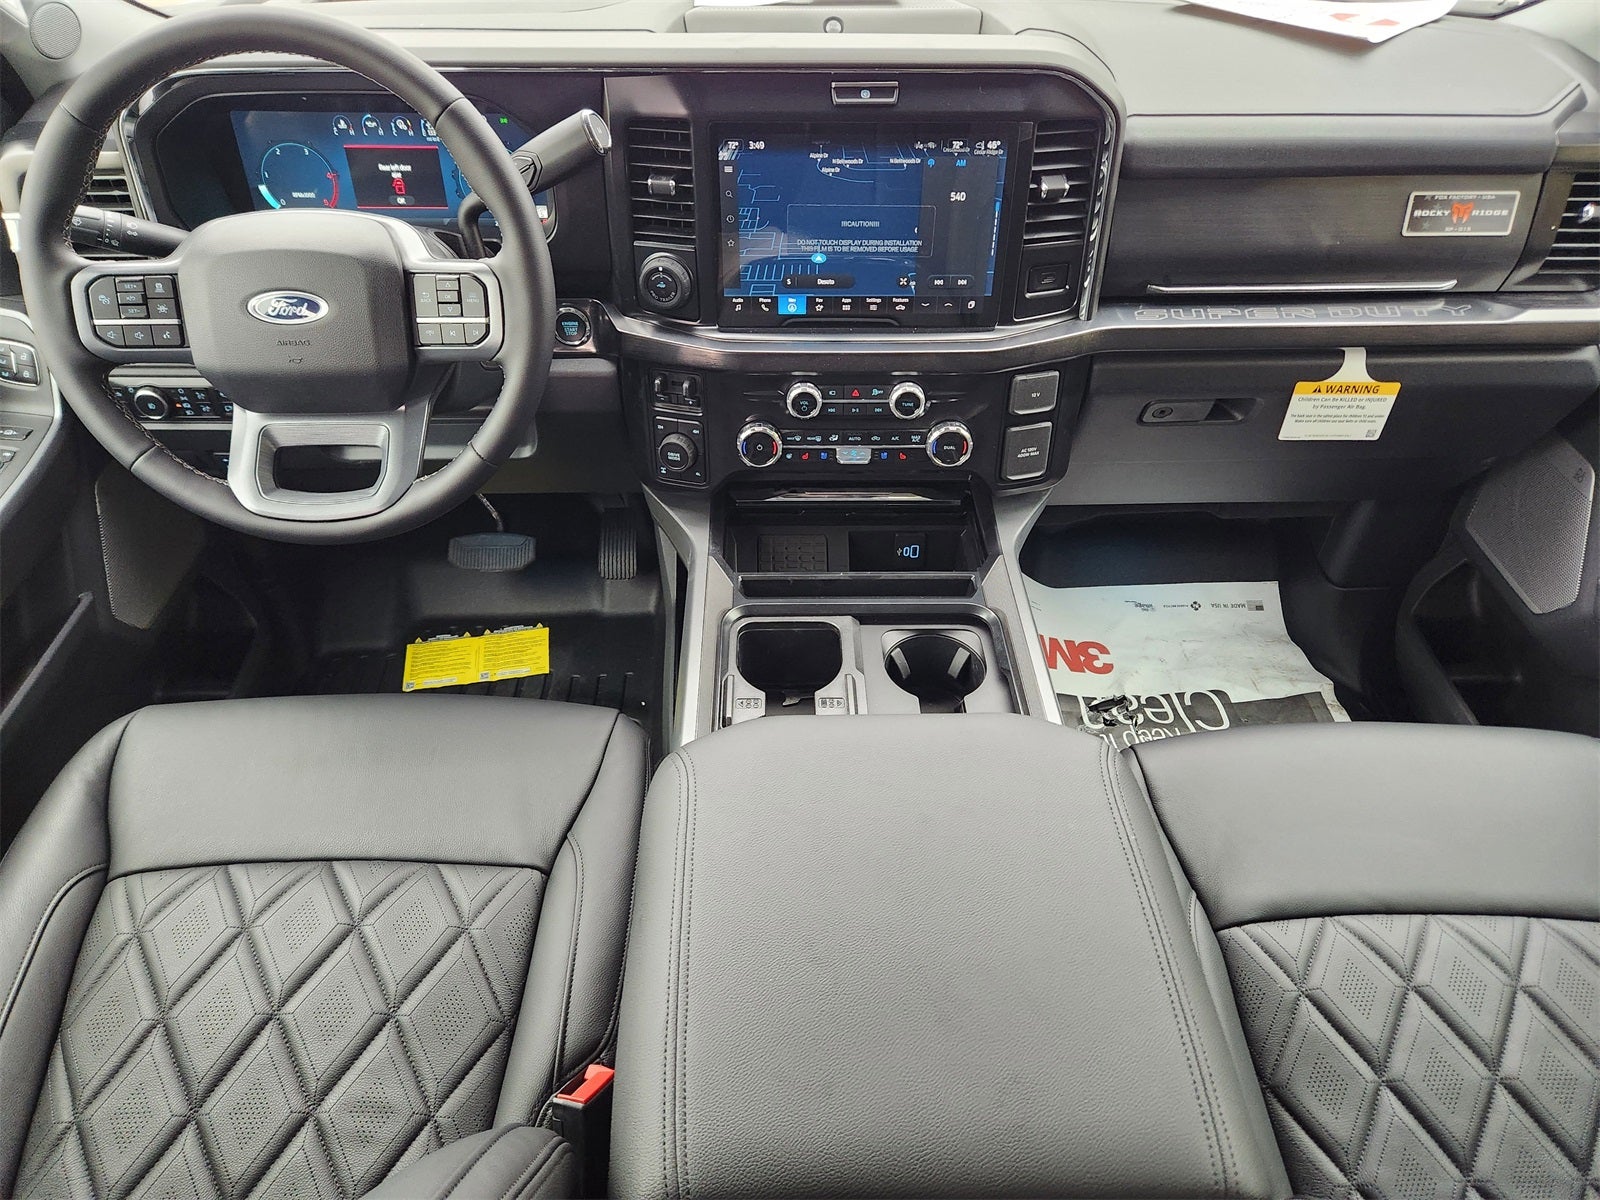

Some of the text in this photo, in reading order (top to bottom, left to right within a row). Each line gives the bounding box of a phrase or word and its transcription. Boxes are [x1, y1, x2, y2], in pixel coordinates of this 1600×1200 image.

[748, 141, 764, 150] 3:49
[950, 192, 966, 201] 540
[267, 298, 318, 317] Ford
[1134, 304, 1470, 321] SUPER DUTY
[1325, 385, 1380, 394] WARNING
[1039, 634, 1114, 675] 3M
